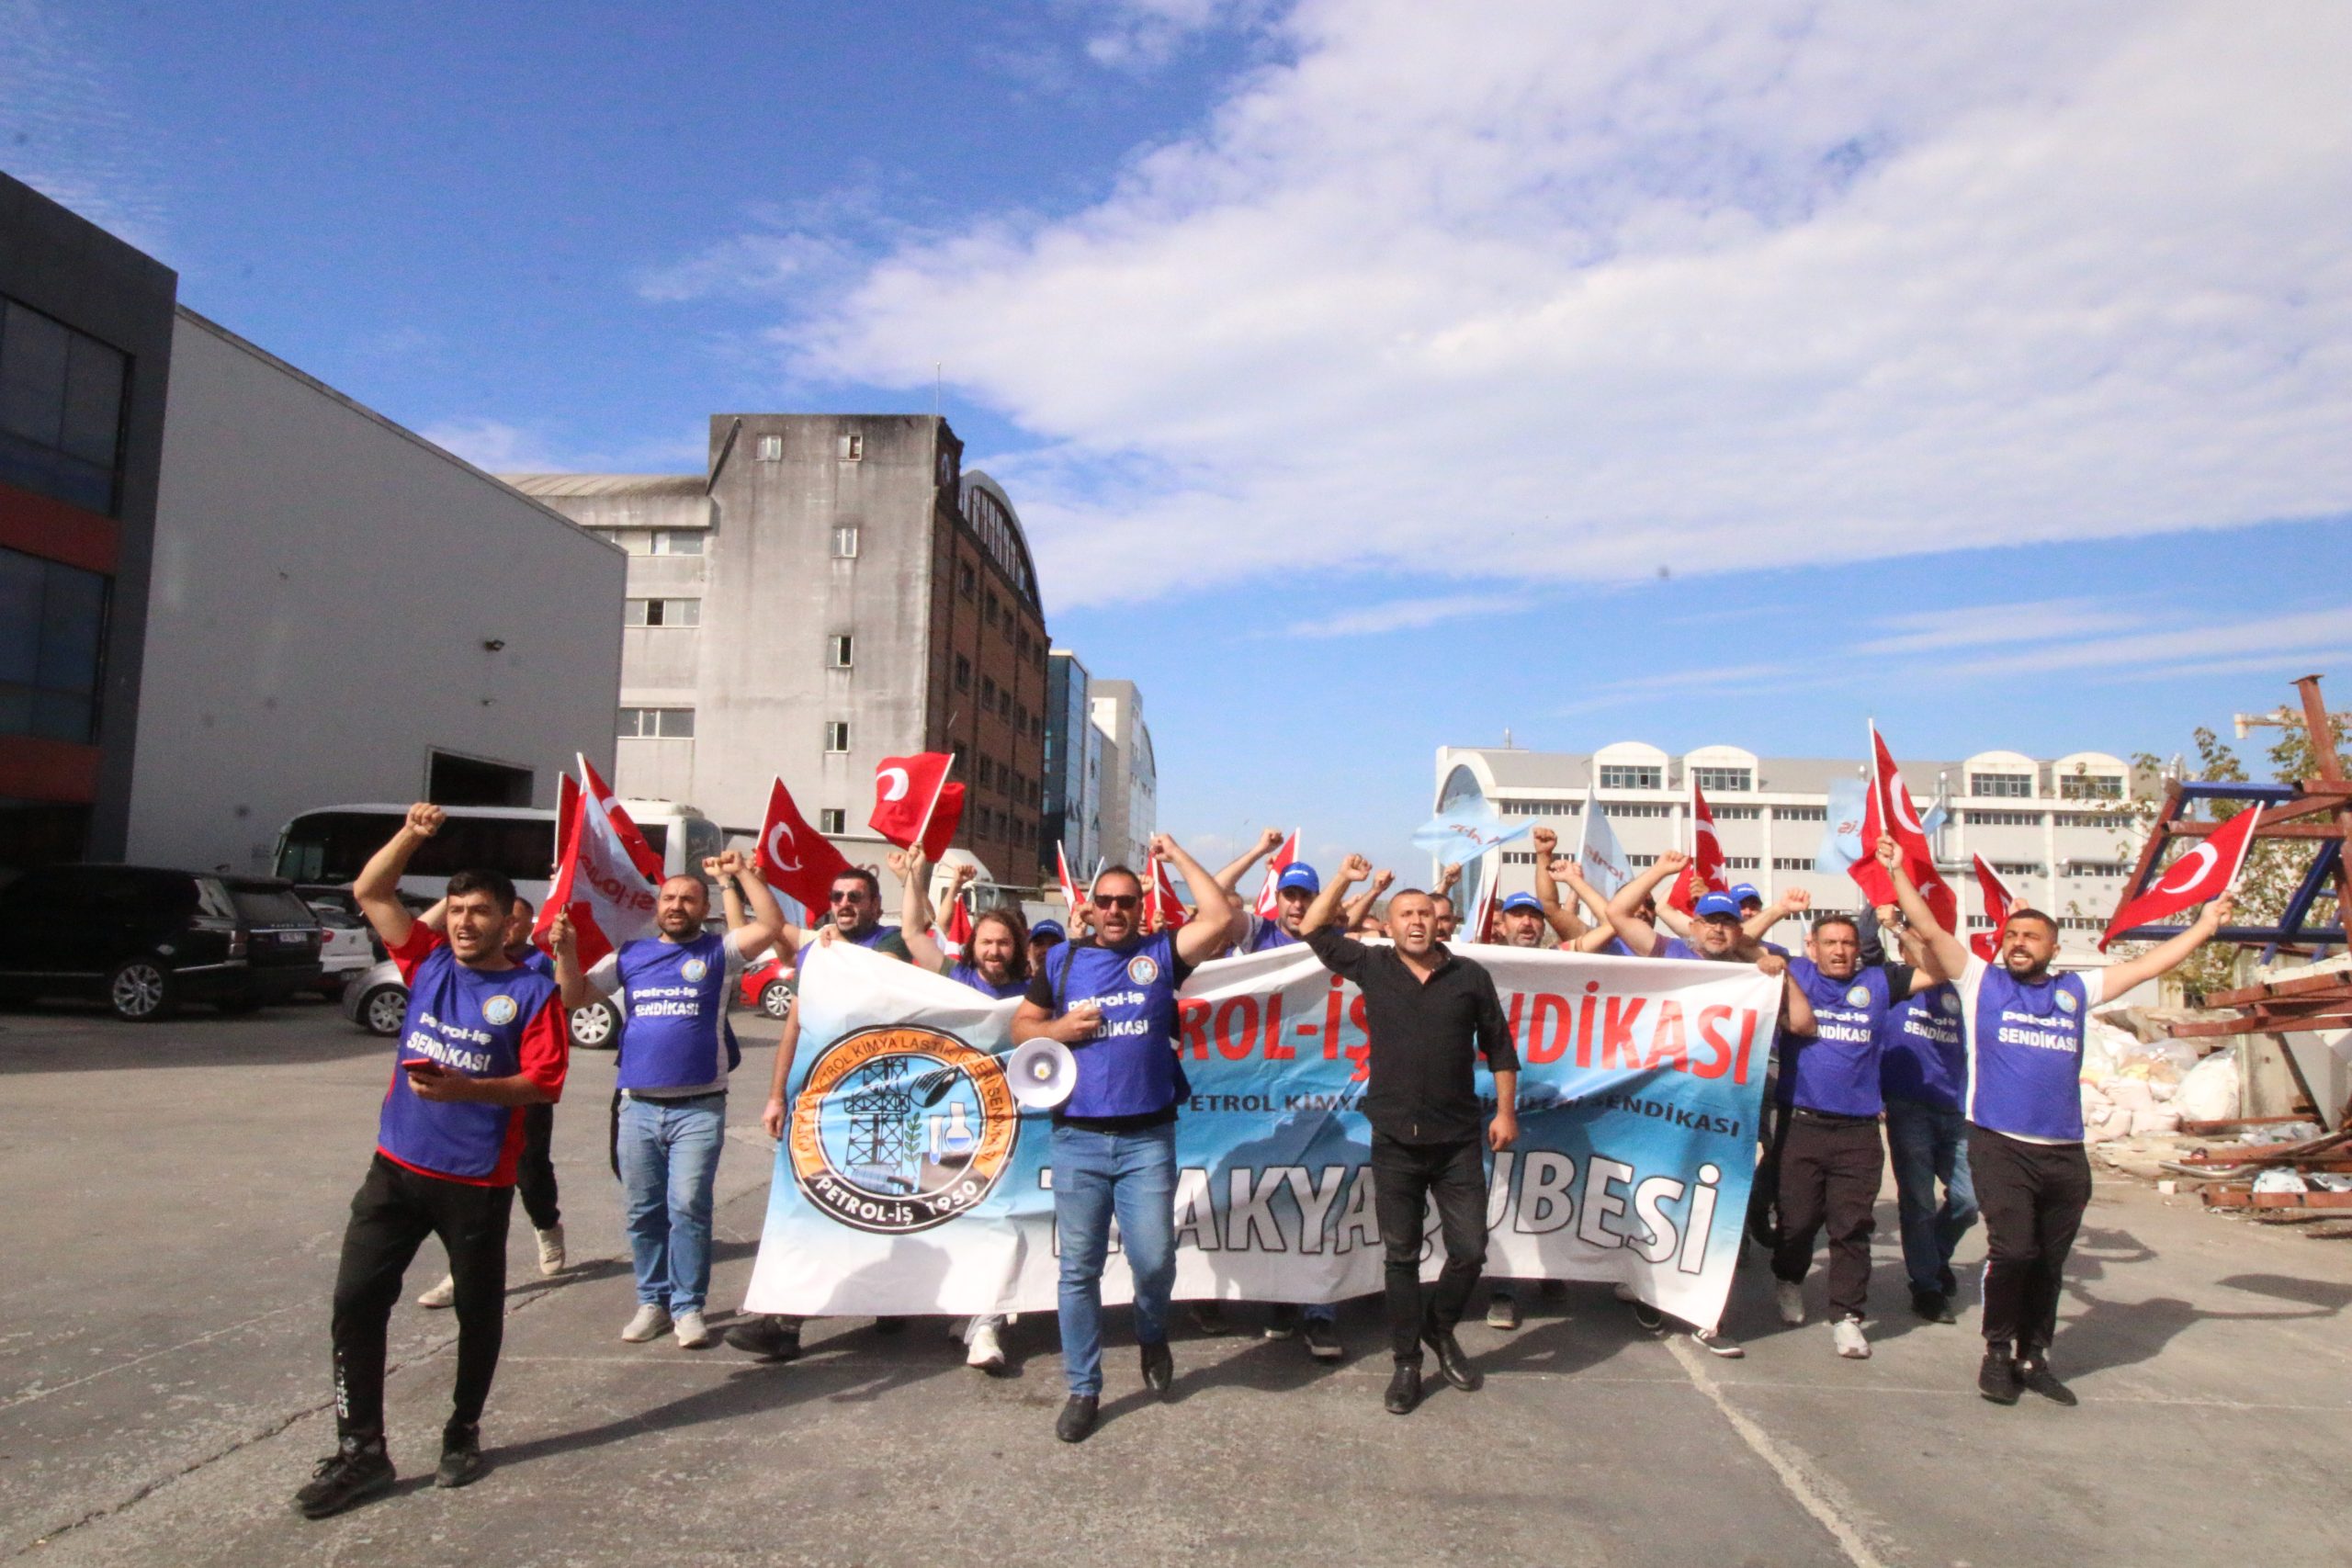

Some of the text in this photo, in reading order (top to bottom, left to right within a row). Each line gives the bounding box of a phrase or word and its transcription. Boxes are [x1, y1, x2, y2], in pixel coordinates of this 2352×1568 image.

[1814, 1009, 1870, 1023] etrol-iş
[1178, 974, 1758, 1085] ROL-İŞ DİKASI
[1816, 1023, 1871, 1043] NDİKASI
[1998, 1027, 2078, 1053] SENDİKASI
[406, 1031, 492, 1072] SENDİKASI
[852, 1036, 899, 1058] KİMYA
[900, 1036, 956, 1057] LASTİK
[1191, 1094, 1277, 1112] ETROL
[815, 1177, 978, 1225] PETROL-İŞ 1950
[1039, 1166, 1381, 1258] AKYA
